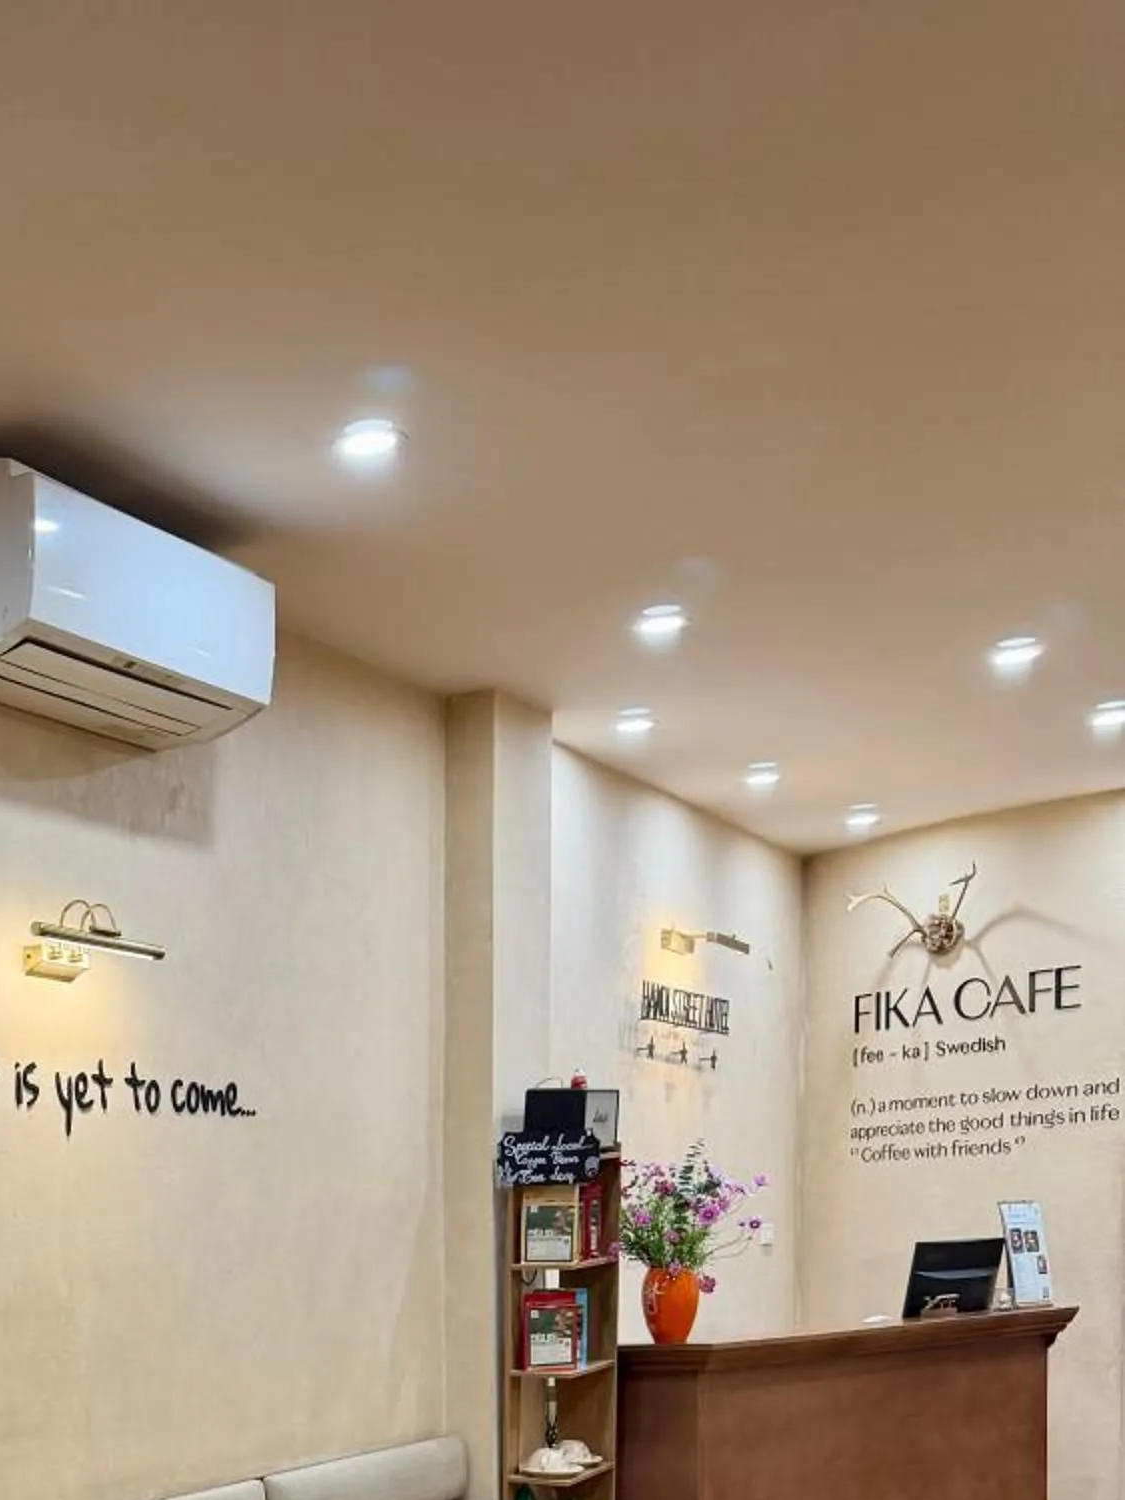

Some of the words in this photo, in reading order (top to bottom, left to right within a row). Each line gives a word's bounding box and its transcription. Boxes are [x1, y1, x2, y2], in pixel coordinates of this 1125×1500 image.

[853, 986, 944, 1034] FIKA
[953, 965, 1082, 1020] CAFE
[936, 1035, 1006, 1057] Swedish
[14, 1061, 40, 1109] is
[55, 1058, 114, 1138] yet
[124, 1061, 161, 1114] to
[171, 1078, 257, 1118] come...
[878, 1101, 886, 1113] a
[889, 1094, 956, 1112] moment
[960, 1092, 979, 1105] to
[982, 1087, 1022, 1104] slow
[1026, 1083, 1078, 1101] down
[1082, 1077, 1120, 1097] and
[850, 1121, 926, 1140] appreciate
[929, 1117, 956, 1133] the
[960, 1111, 1004, 1135] good
[1010, 1108, 1066, 1129] things
[1069, 1107, 1086, 1124] in
[1090, 1103, 1121, 1121] life
[914, 1142, 948, 1159] with
